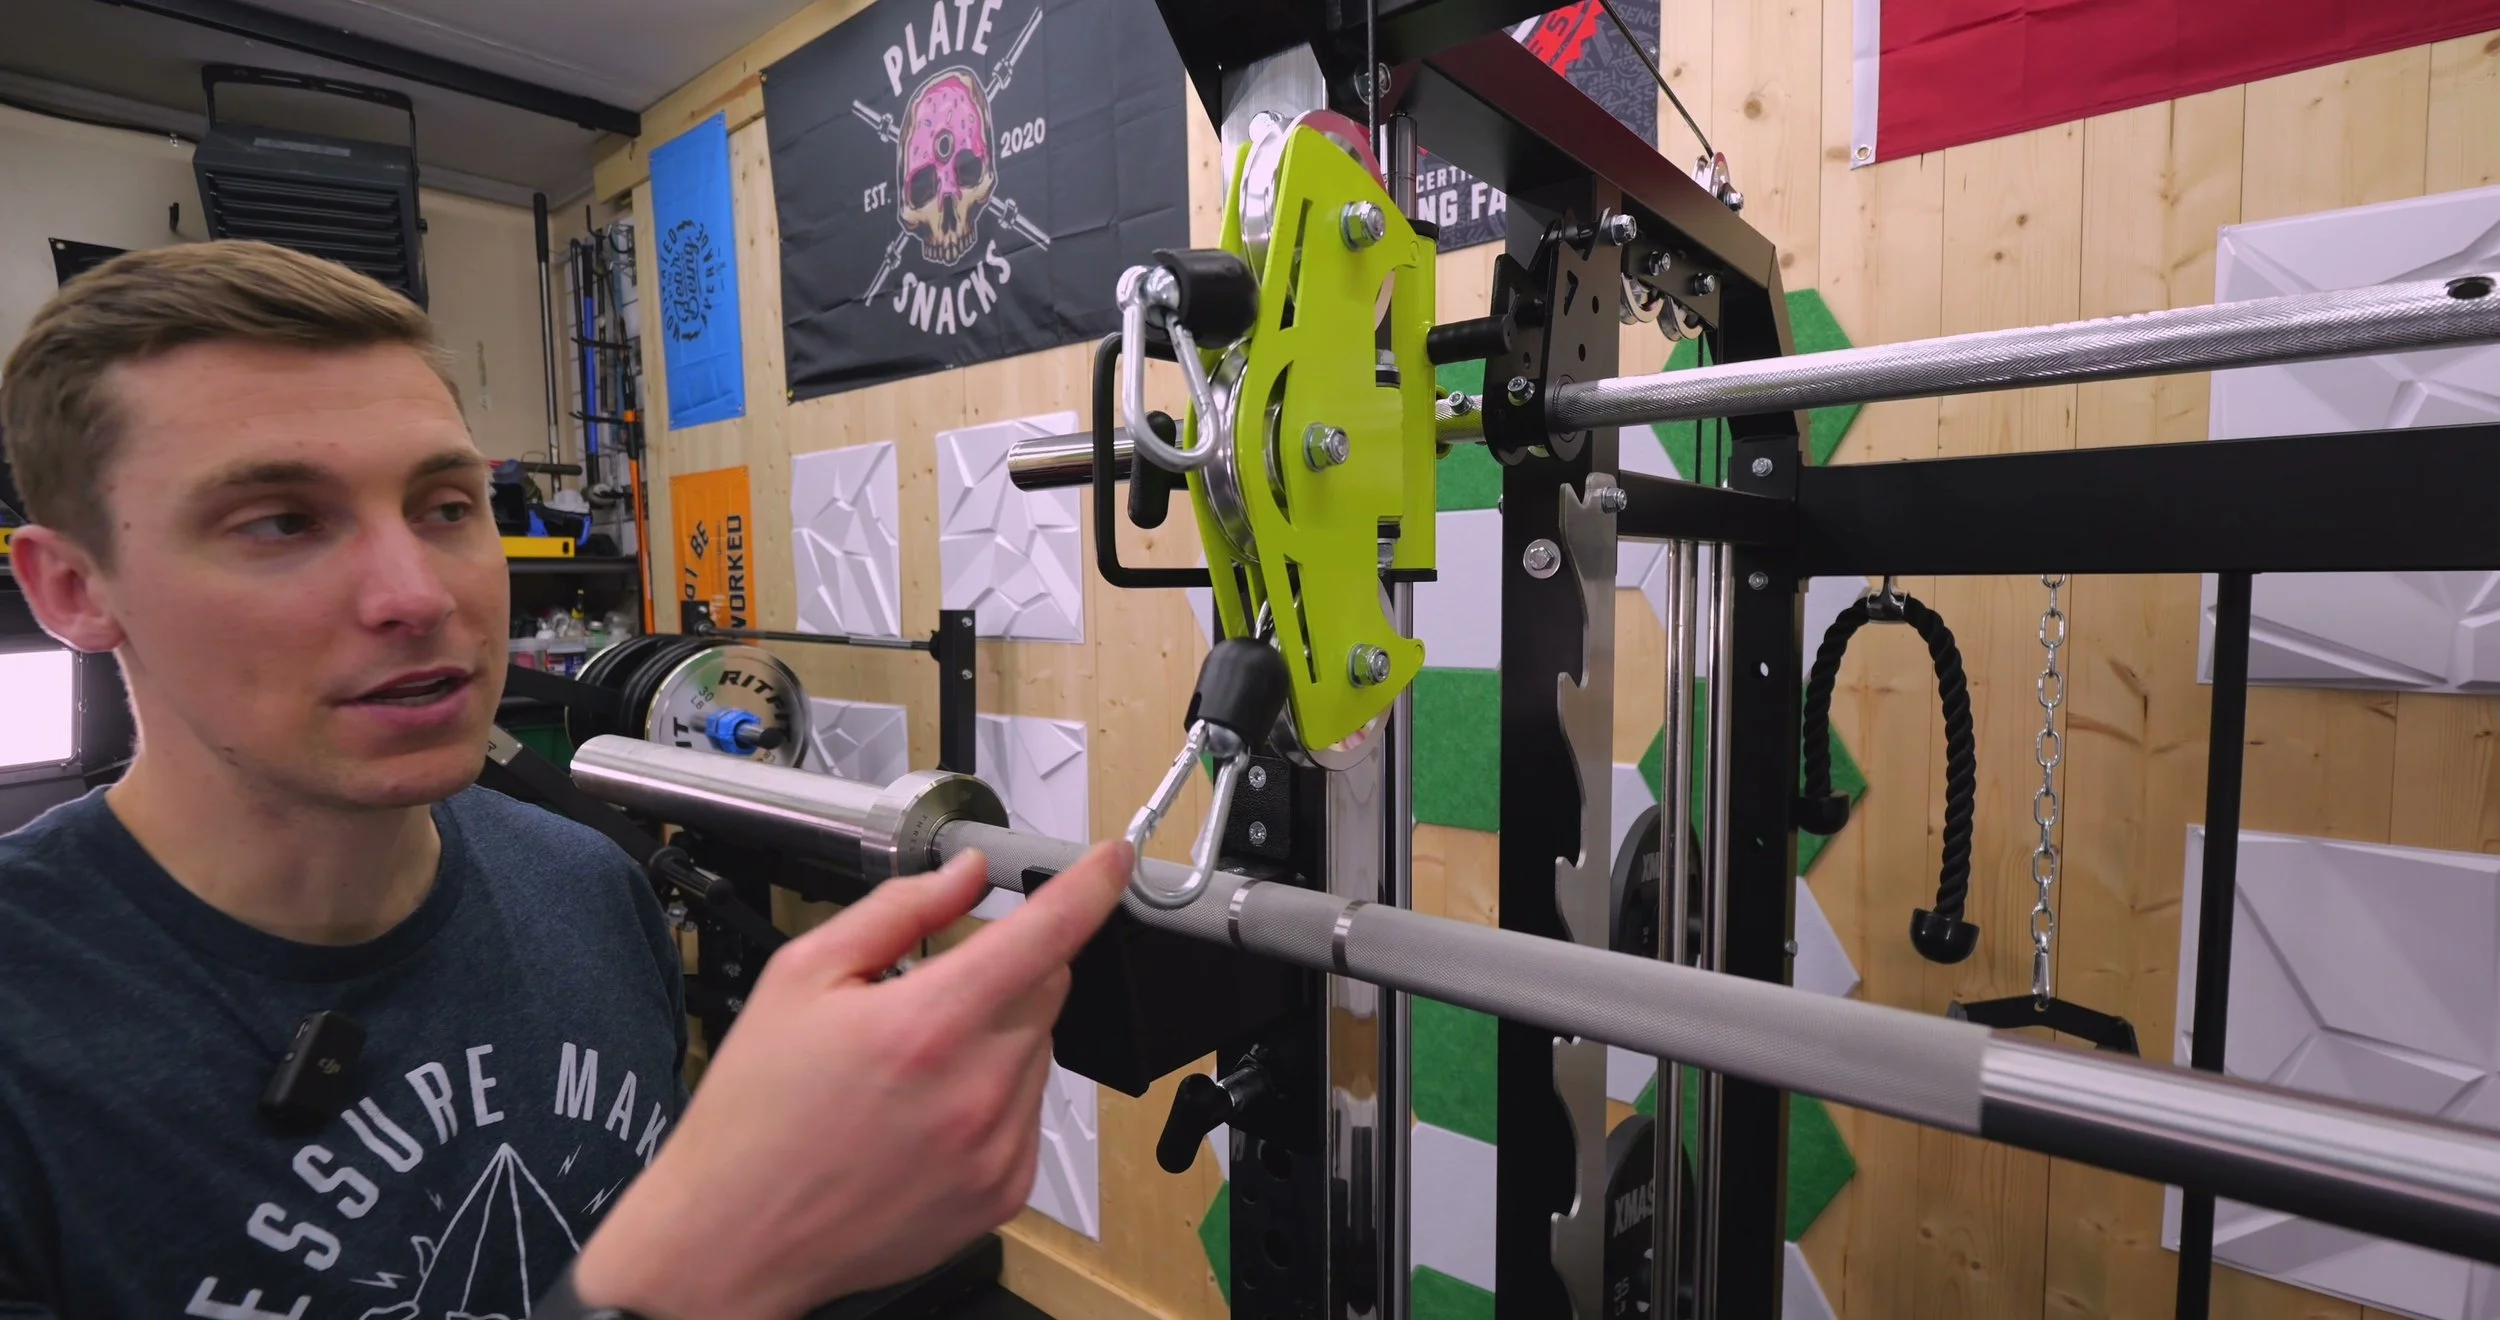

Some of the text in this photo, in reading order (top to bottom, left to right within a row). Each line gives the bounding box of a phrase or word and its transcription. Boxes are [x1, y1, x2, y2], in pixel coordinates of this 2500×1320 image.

[883, 0, 1002, 97] PLATE
[1000, 117, 1046, 159] 2020
[863, 181, 891, 213] EST.
[892, 239, 1012, 336] SNACKS
[690, 520, 709, 560] BE
[690, 695, 705, 710] LB
[698, 686, 715, 702] 30
[1613, 1276, 1630, 1302] 35
